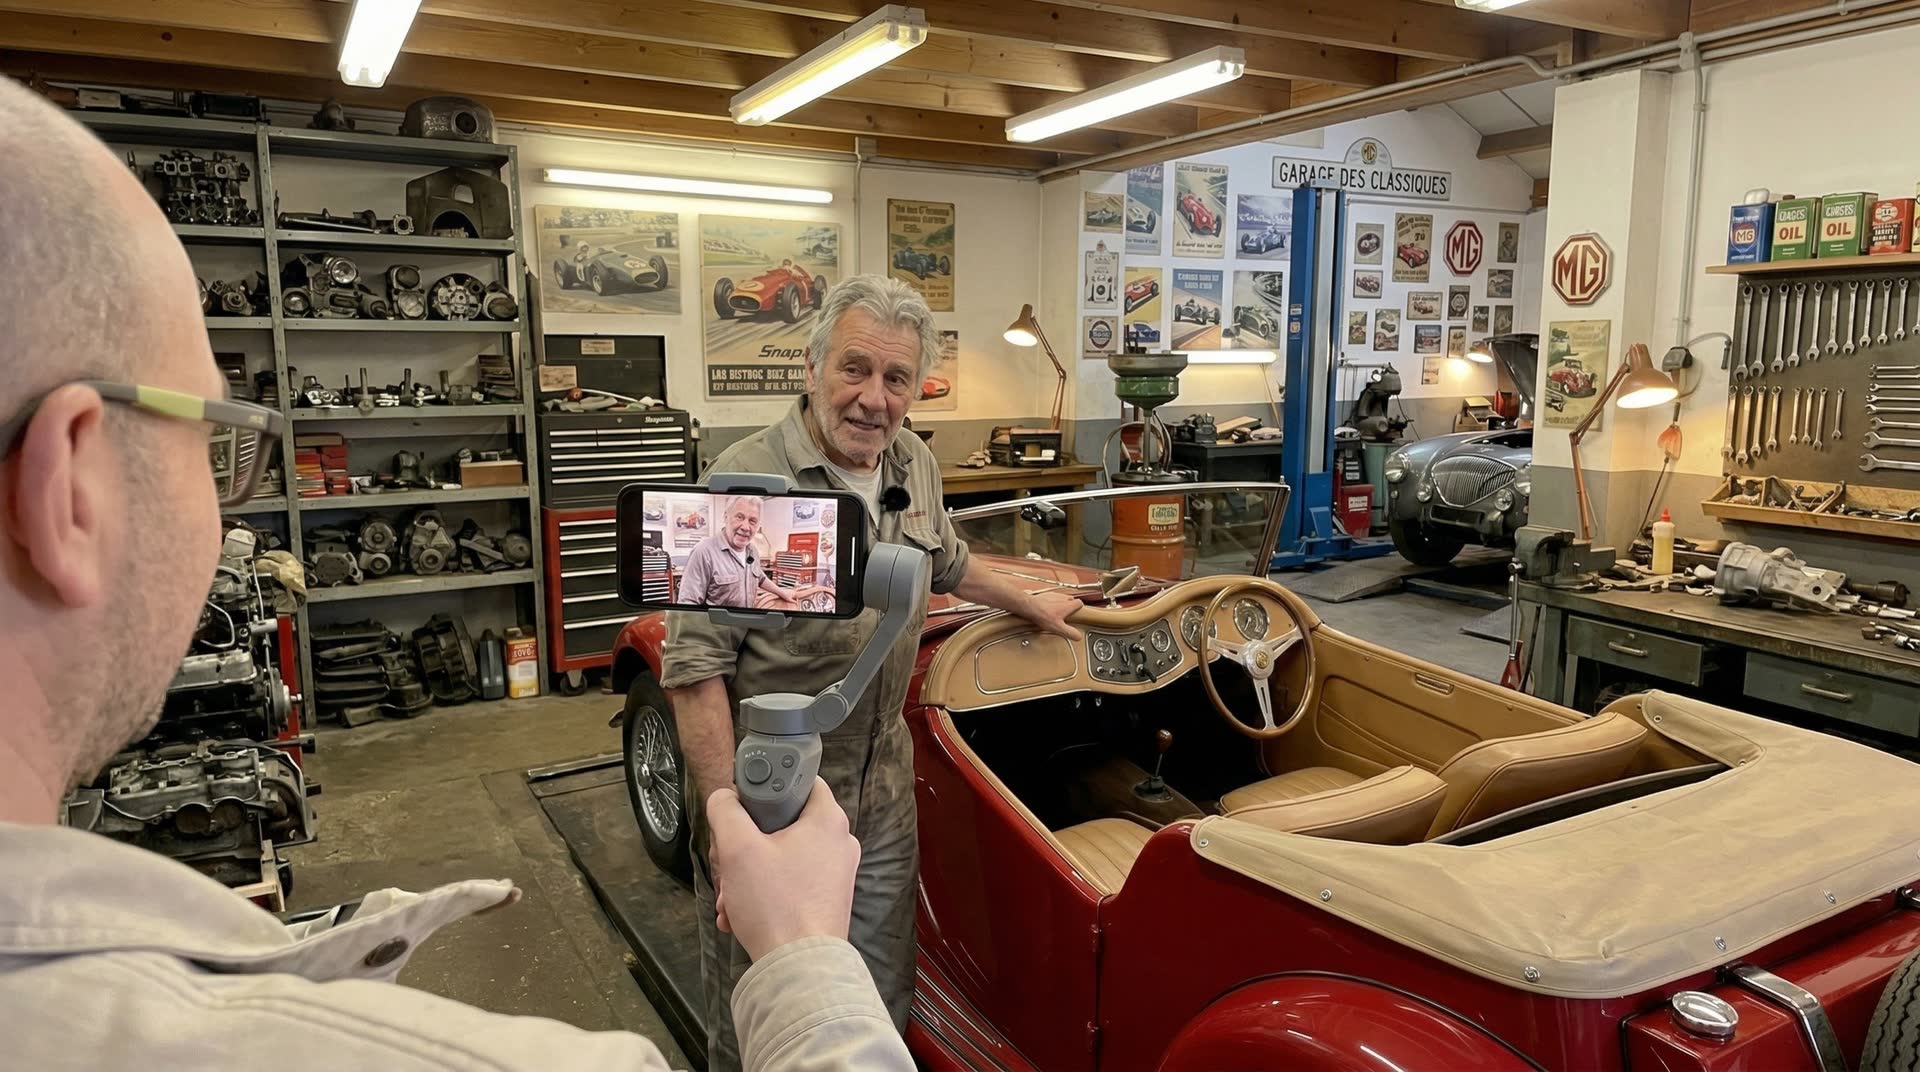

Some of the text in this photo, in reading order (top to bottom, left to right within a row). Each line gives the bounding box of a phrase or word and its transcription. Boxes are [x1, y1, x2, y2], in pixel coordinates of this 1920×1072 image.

[1340, 168, 1365, 188] DES
[1371, 170, 1447, 195] CLASSIQUES
[1736, 230, 1754, 242] MG
[1779, 226, 1803, 240] OIL
[1826, 222, 1851, 237] OIL
[1452, 229, 1479, 268] MG
[1557, 244, 1600, 296] MG
[758, 344, 805, 360] Snap
